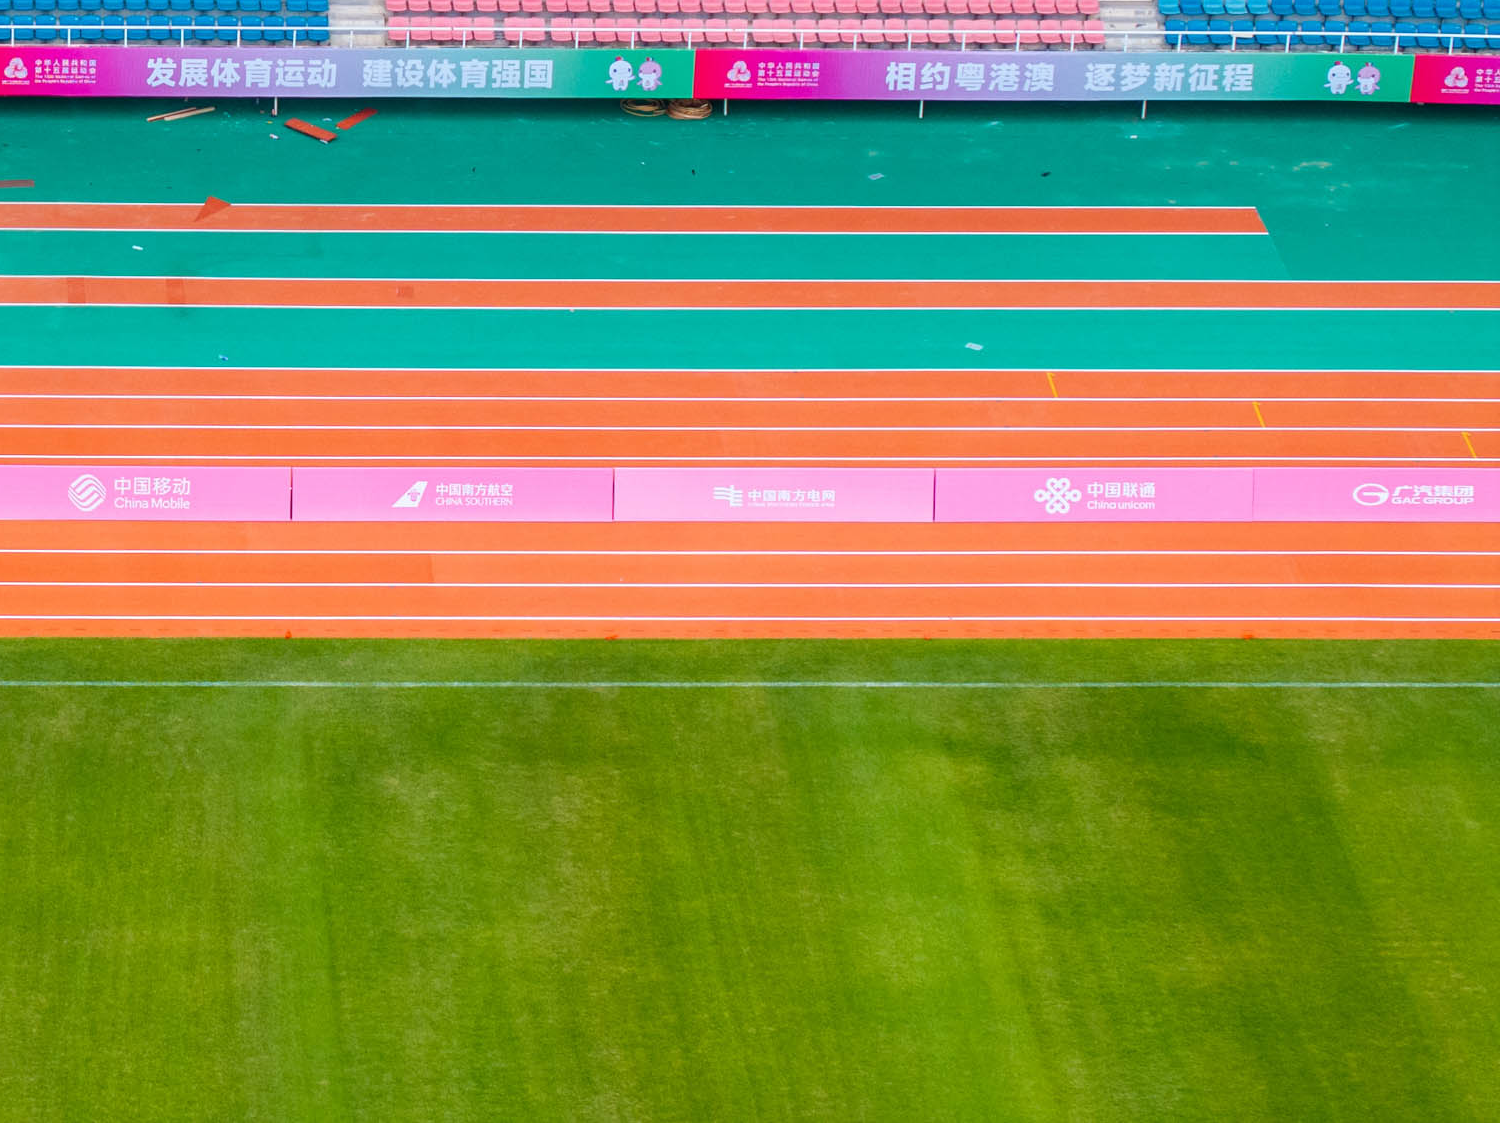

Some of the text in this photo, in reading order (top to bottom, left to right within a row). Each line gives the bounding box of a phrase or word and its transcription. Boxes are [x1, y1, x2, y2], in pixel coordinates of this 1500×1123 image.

[146, 57, 554, 89] 发展体育运动 建设体育强国
[885, 61, 1255, 92] 相约粤港澳 逐梦新征程
[114, 476, 191, 495] 中国移动
[435, 483, 513, 496] 中国南方航空
[1087, 481, 1156, 498] 中国联通
[1392, 485, 1474, 497] 广汽集团
[435, 497, 513, 506] CHINA SOUTHERN
[747, 489, 836, 502] 中国南方电网
[1391, 497, 1475, 505] GAC GROUP
[114, 497, 190, 510] China Mobile
[1087, 500, 1156, 510] China unicom
